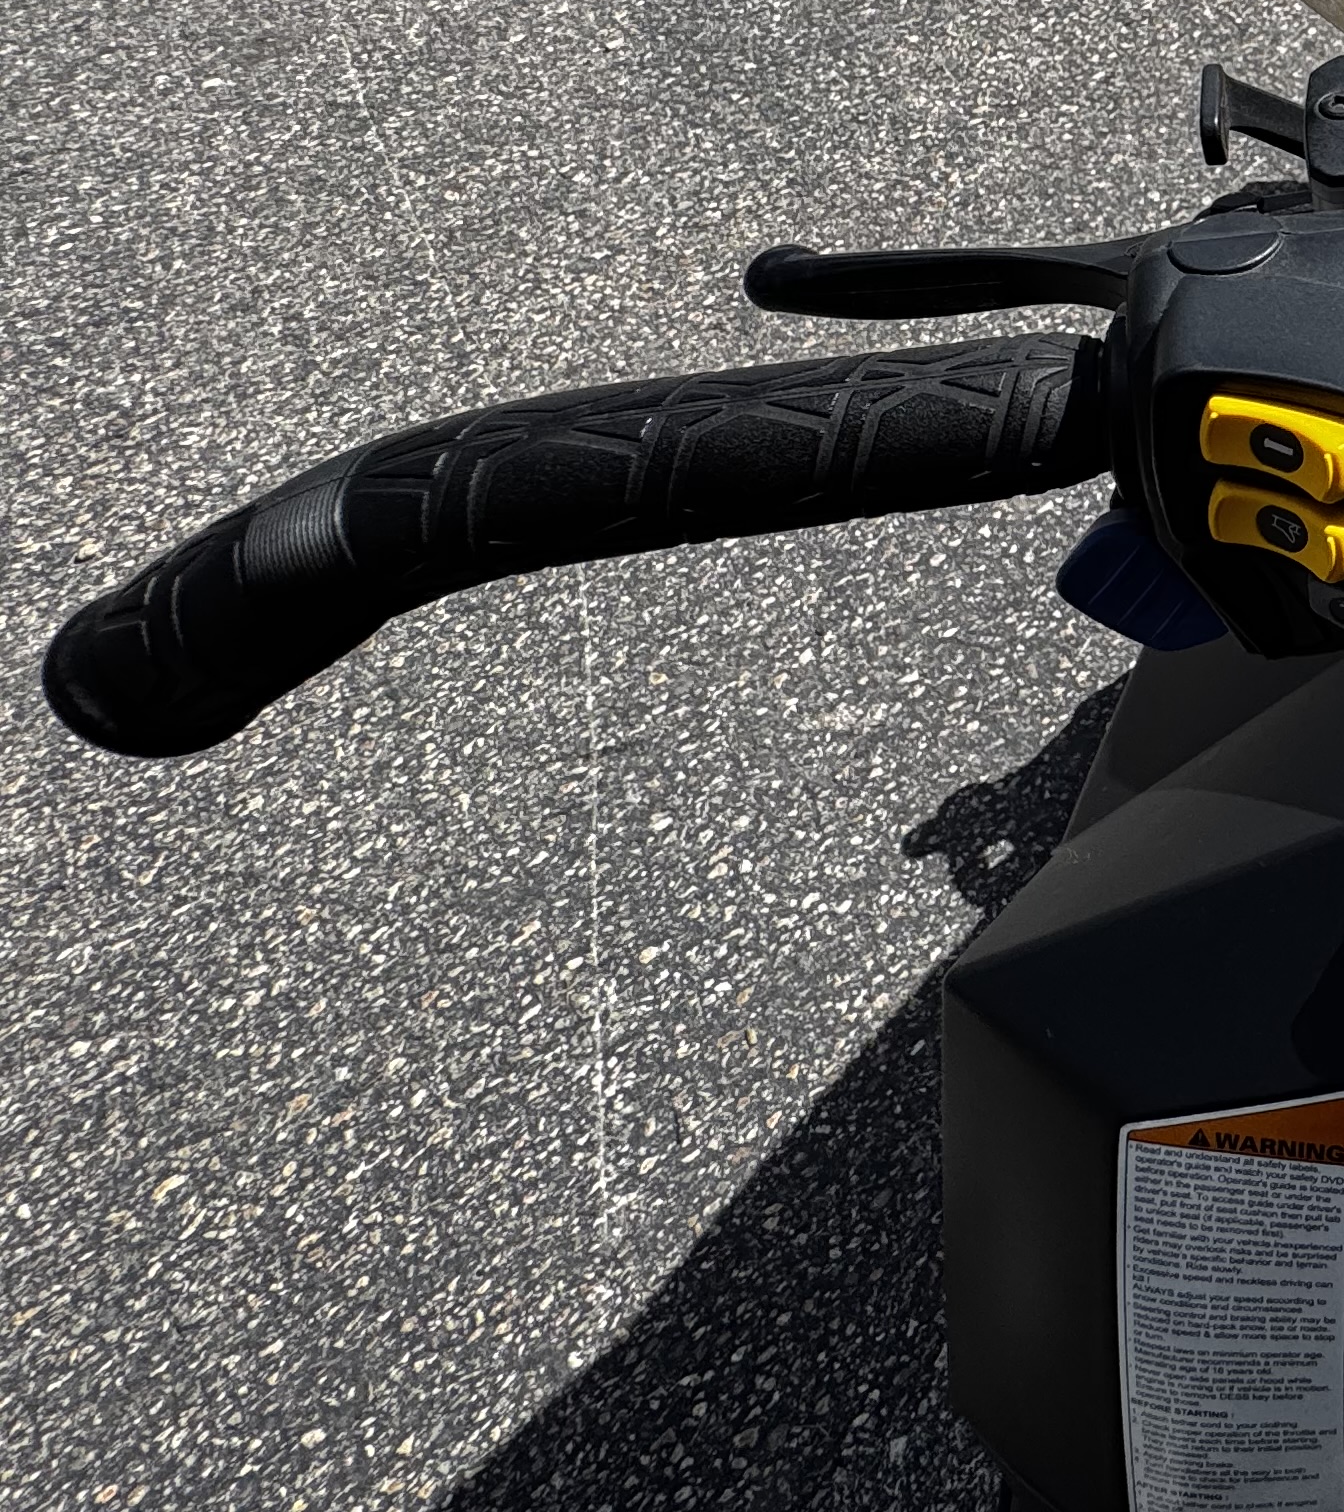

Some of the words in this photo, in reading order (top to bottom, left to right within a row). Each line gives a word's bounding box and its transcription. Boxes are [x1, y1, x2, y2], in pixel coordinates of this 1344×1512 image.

[1135, 1144, 1161, 1155] Read
[1185, 1151, 1240, 1164] understand
[1257, 1159, 1286, 1171] safety
[1135, 1165, 1166, 1176] before
[1310, 1184, 1344, 1195] located
[1185, 1162, 1211, 1172] guide
[1266, 1171, 1287, 1181] your
[1290, 1172, 1318, 1184] safety
